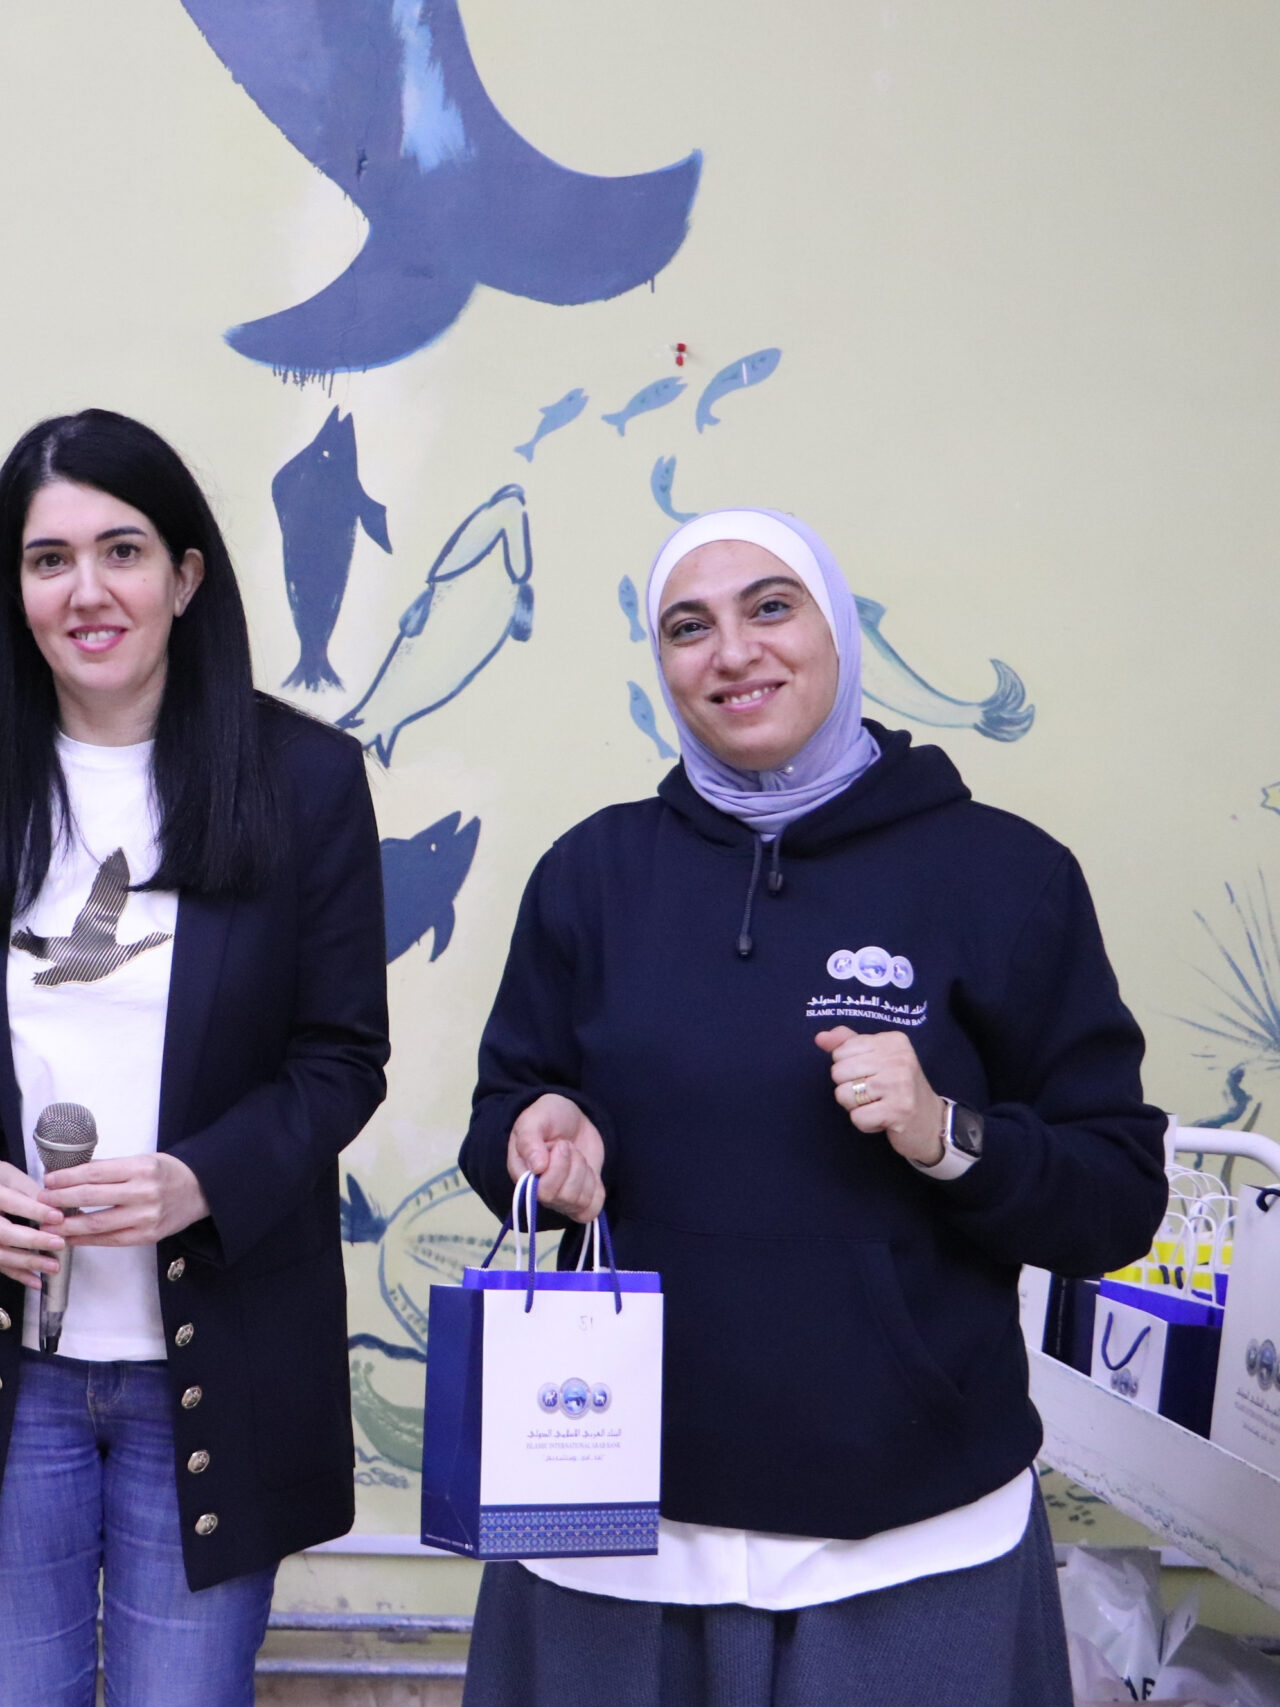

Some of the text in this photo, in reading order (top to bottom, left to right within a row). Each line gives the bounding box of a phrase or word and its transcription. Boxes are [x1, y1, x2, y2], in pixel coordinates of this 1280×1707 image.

[806, 1008, 836, 1017] ISLAMIC
[836, 1008, 892, 1023] INTERNATIONAL
[892, 1016, 911, 1026] ARAB
